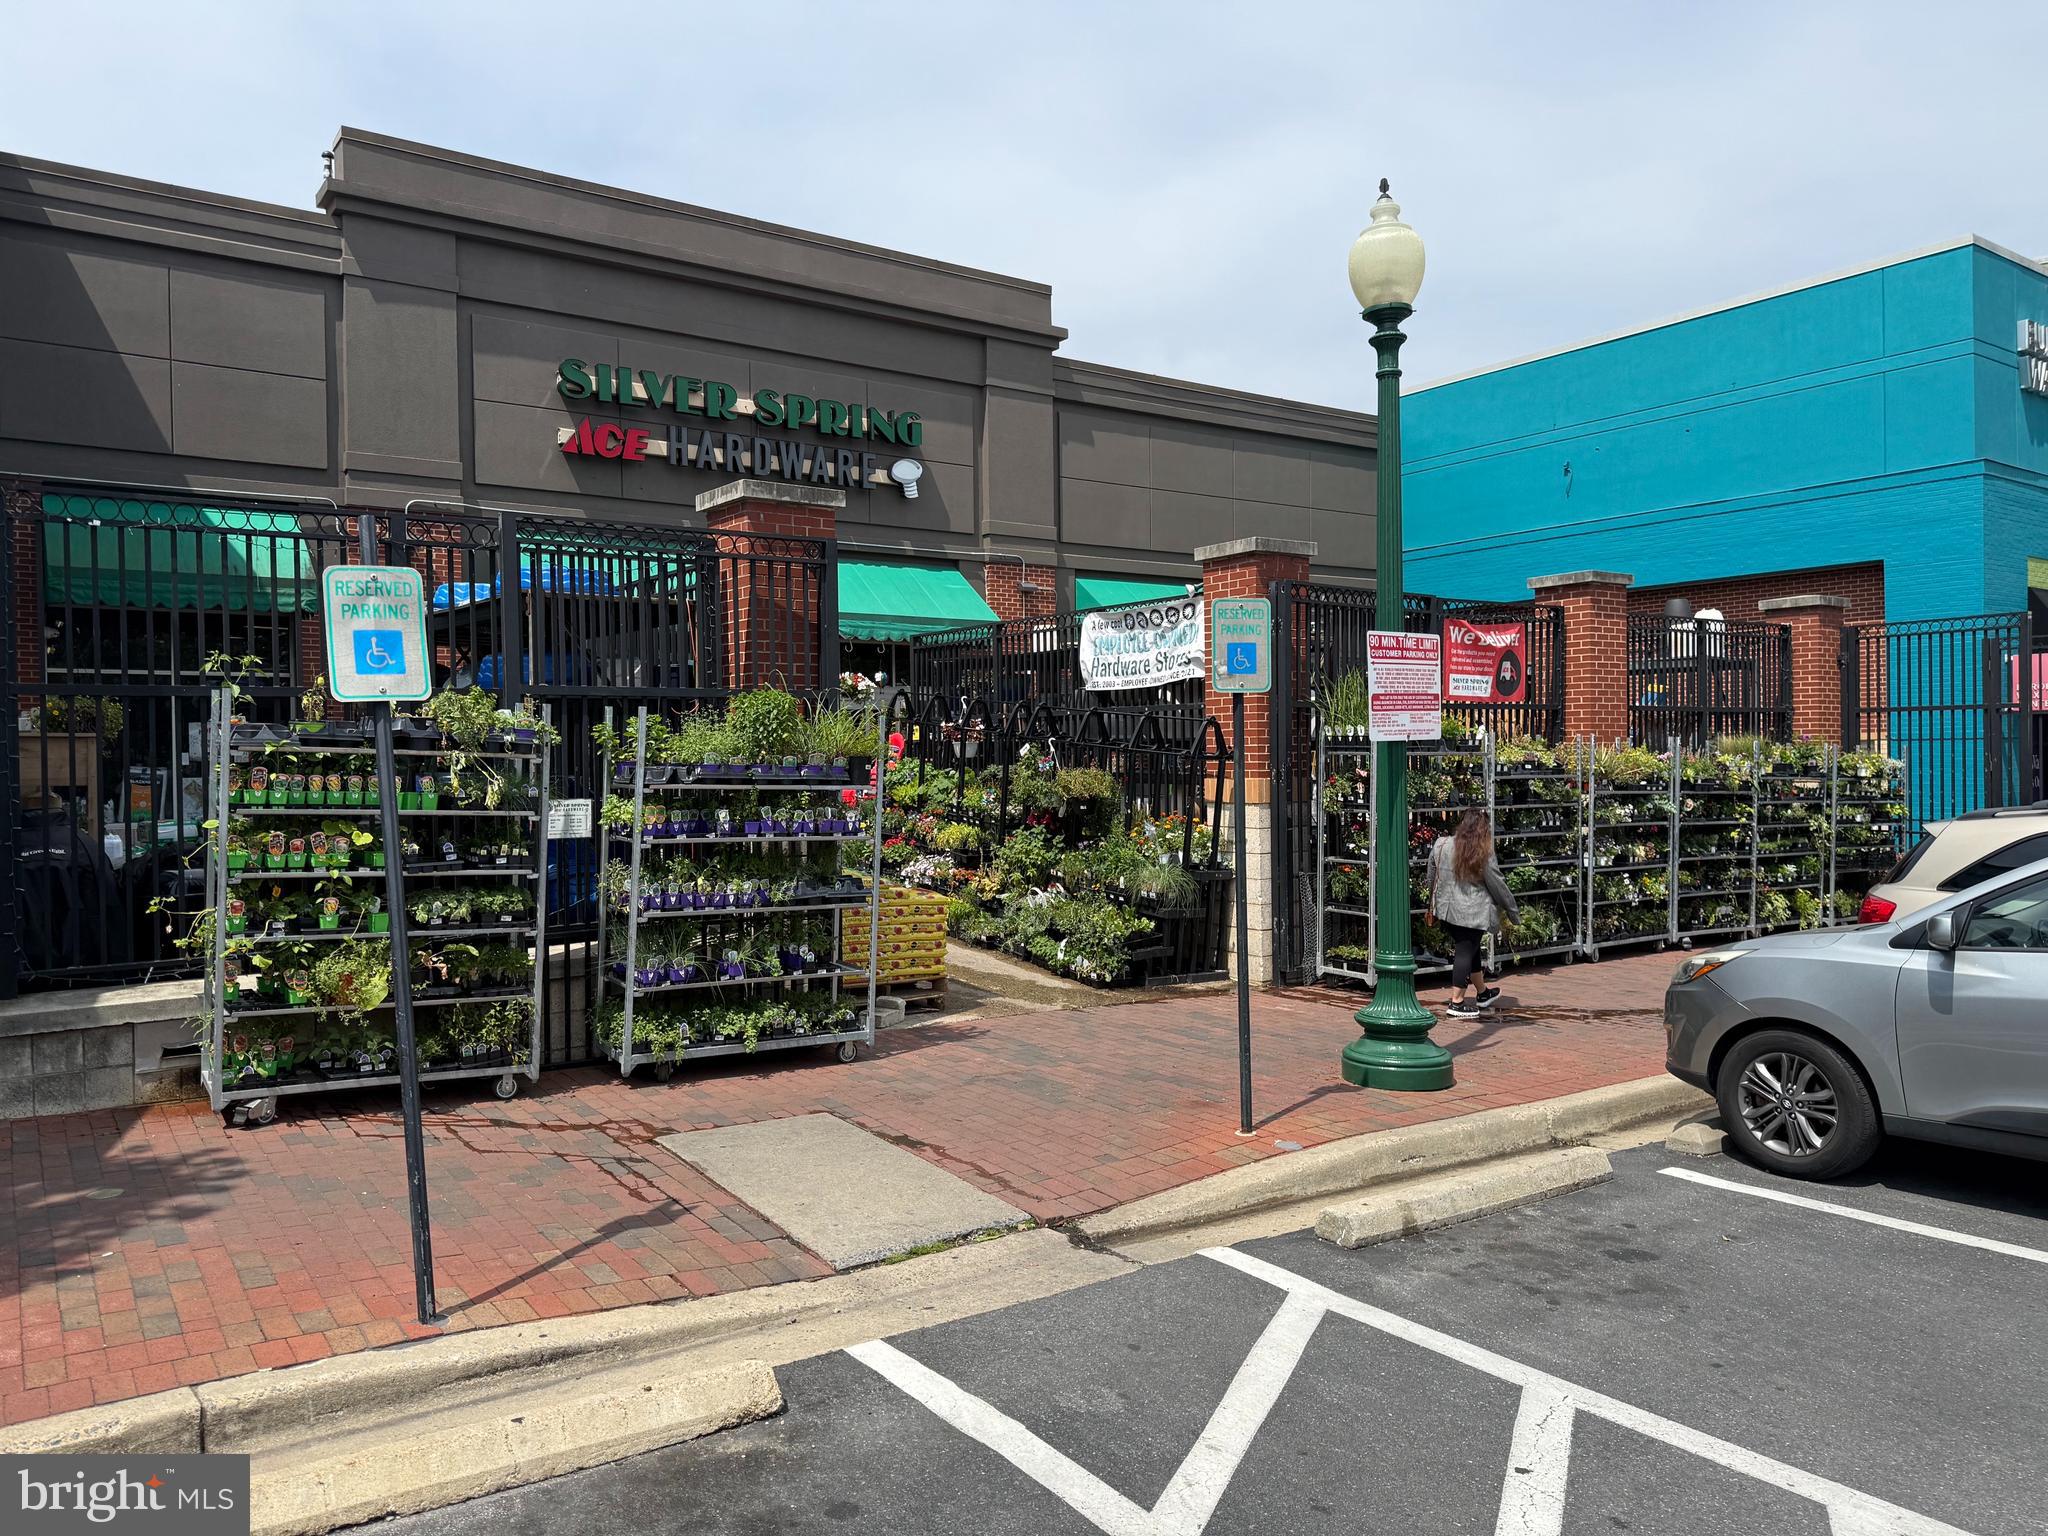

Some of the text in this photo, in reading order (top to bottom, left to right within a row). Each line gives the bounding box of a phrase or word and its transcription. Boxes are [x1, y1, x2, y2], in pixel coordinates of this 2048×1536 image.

[557, 358, 923, 447] SILVER SPRING
[561, 416, 878, 490] ACE HARDWARE
[335, 580, 413, 597] RESERVED
[341, 603, 410, 620] PARKING
[1218, 608, 1264, 620] RESERVED
[1220, 624, 1262, 637] PARKING
[1449, 625, 1520, 648] We Deliver
[1369, 635, 1379, 647] 90
[1418, 638, 1438, 650] LIMIT
[1370, 649, 1438, 660] CUSTOMER PARKING ONLY
[1090, 650, 1192, 678] Hardware Stores
[1121, 678, 1148, 687] EMPLOYEE
